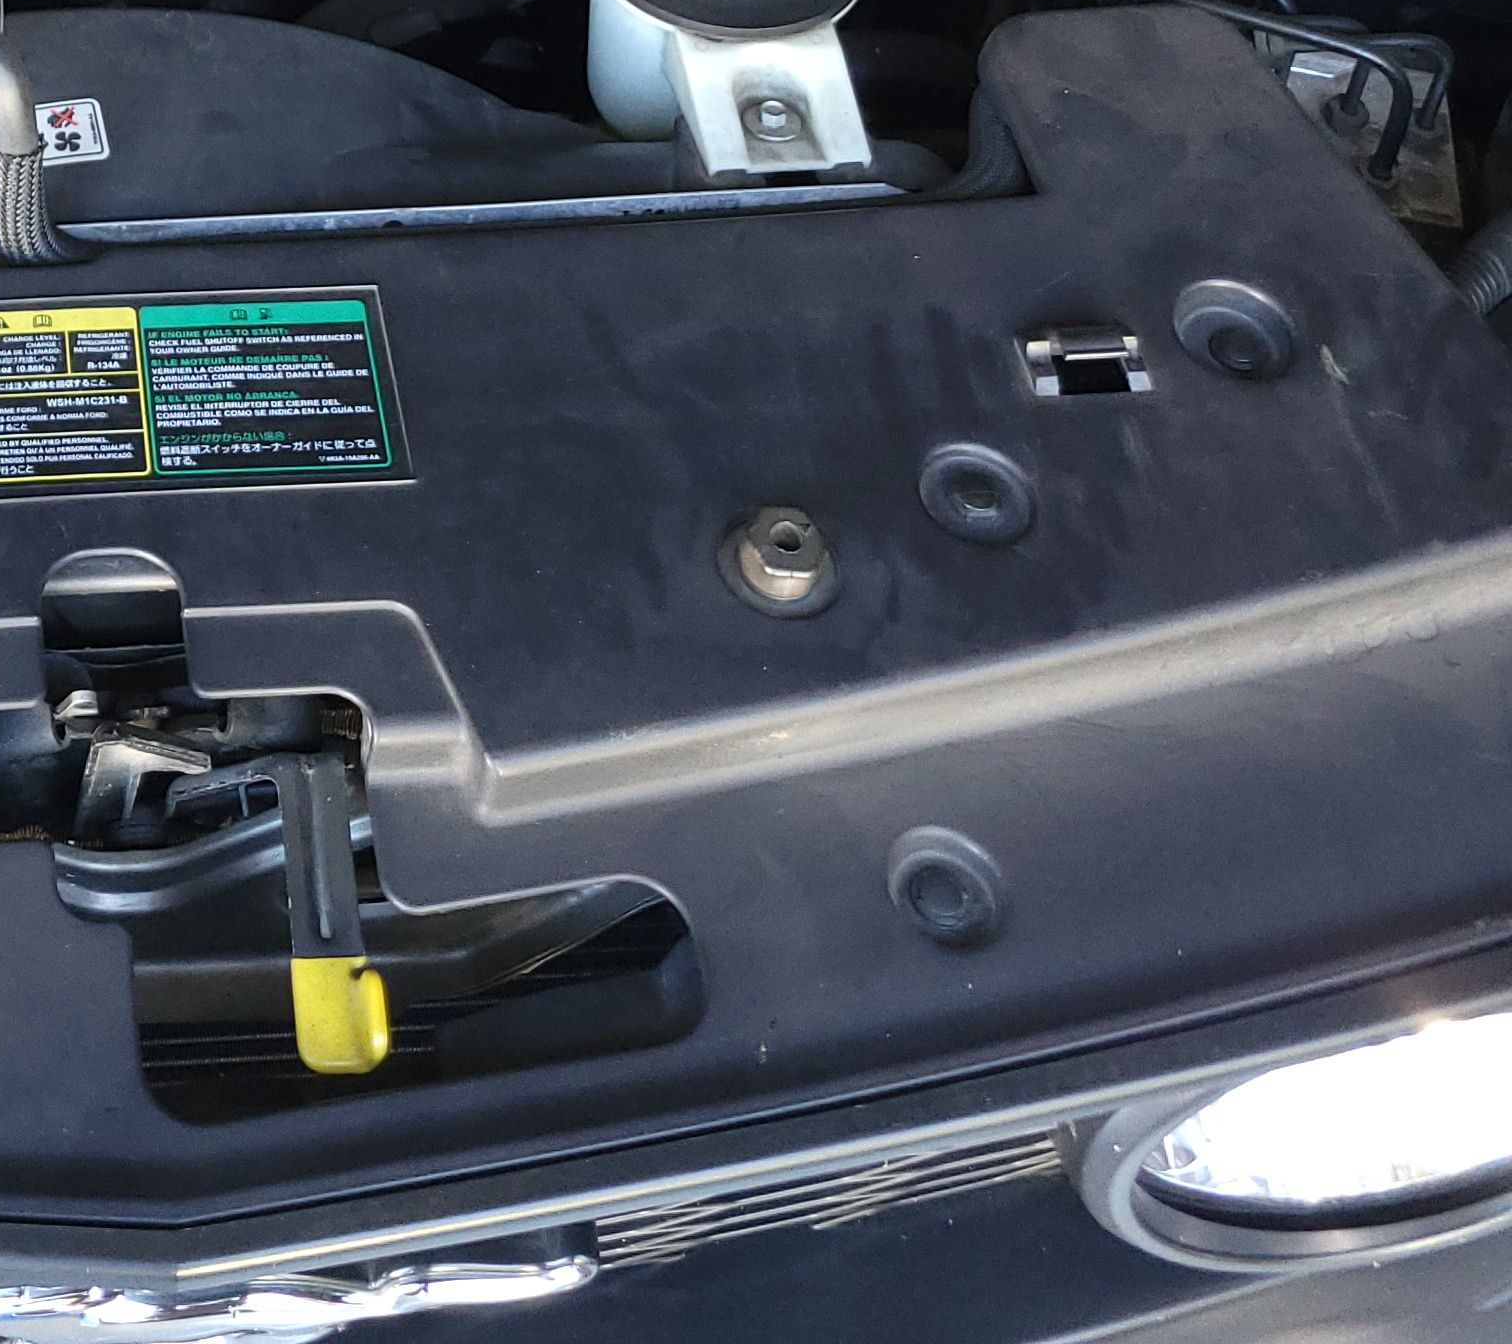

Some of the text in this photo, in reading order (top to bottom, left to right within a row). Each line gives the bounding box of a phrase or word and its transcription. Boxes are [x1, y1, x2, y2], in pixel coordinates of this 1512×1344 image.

[203, 329, 232, 337] FAILS
[3, 335, 33, 343] CHARGE
[204, 337, 244, 345] SHUTOFF
[246, 336, 279, 344] SWITCH
[280, 335, 293, 343] AS
[294, 334, 352, 342] REFERENCED
[87, 361, 120, 370] R-134A
[164, 358, 177, 366] LE
[181, 357, 226, 365] MOTEUR
[151, 366, 192, 374] VÉRIFIER
[194, 365, 206, 373] LA
[208, 364, 260, 373] COMMANDE
[262, 363, 273, 371] DE
[276, 362, 319, 371] COUPURE
[152, 374, 209, 383] CARBURANT,
[326, 369, 354, 377] GUIDE
[153, 381, 236, 391] L'AUTOMOBILISTE.
[46, 395, 128, 407] WSH-M1C231-B
[184, 393, 223, 401] MOTOR
[226, 392, 241, 400] NO
[155, 398, 340, 411] REVISE EL INTERRUPTOR DE CIERRE DEL
[156, 410, 222, 419] COMBUSTIBLE
[224, 409, 252, 417] COMO
[254, 408, 266, 416] SE
[269, 408, 300, 416] INDICA
[302, 407, 315, 415] EN
[157, 419, 221, 427] PROPIETARIO.
[9, 439, 19, 447] BY
[21, 438, 60, 446] QUALIFIED
[57, 445, 99, 453] PERSONNEL
[26, 455, 43, 463] SOLO
[59, 453, 93, 461] PERSONAL
